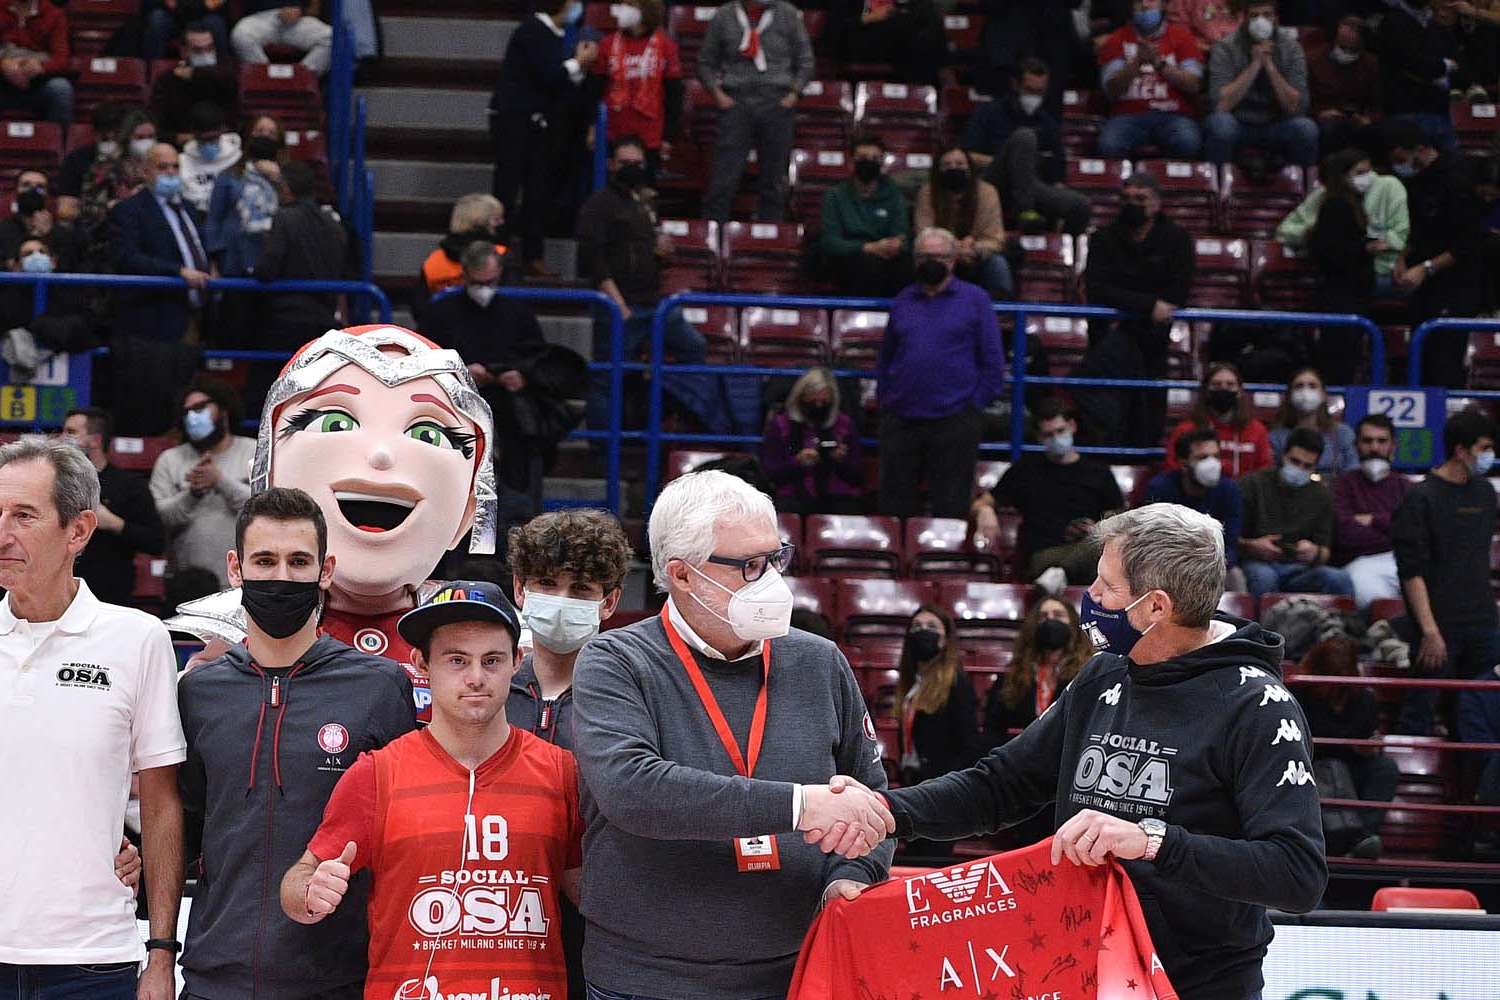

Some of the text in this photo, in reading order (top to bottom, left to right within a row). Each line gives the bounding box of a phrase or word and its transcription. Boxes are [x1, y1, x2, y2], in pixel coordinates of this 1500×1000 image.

[1378, 396, 1416, 421] 22
[56, 668, 111, 688] OSA
[1101, 732, 1160, 755] SOCIAL
[1074, 745, 1174, 806] OSA
[1093, 796, 1118, 811] MILANO
[1118, 803, 1134, 814] SINCE
[1136, 804, 1154, 816] 1948
[464, 814, 509, 861] 18
[440, 870, 529, 885] SOCIAL
[408, 886, 550, 938] OSA
[910, 897, 1017, 930] FRAGRANCES
[422, 940, 457, 950] BASKET
[460, 940, 495, 950] MILANO
[497, 940, 524, 949] SINCE
